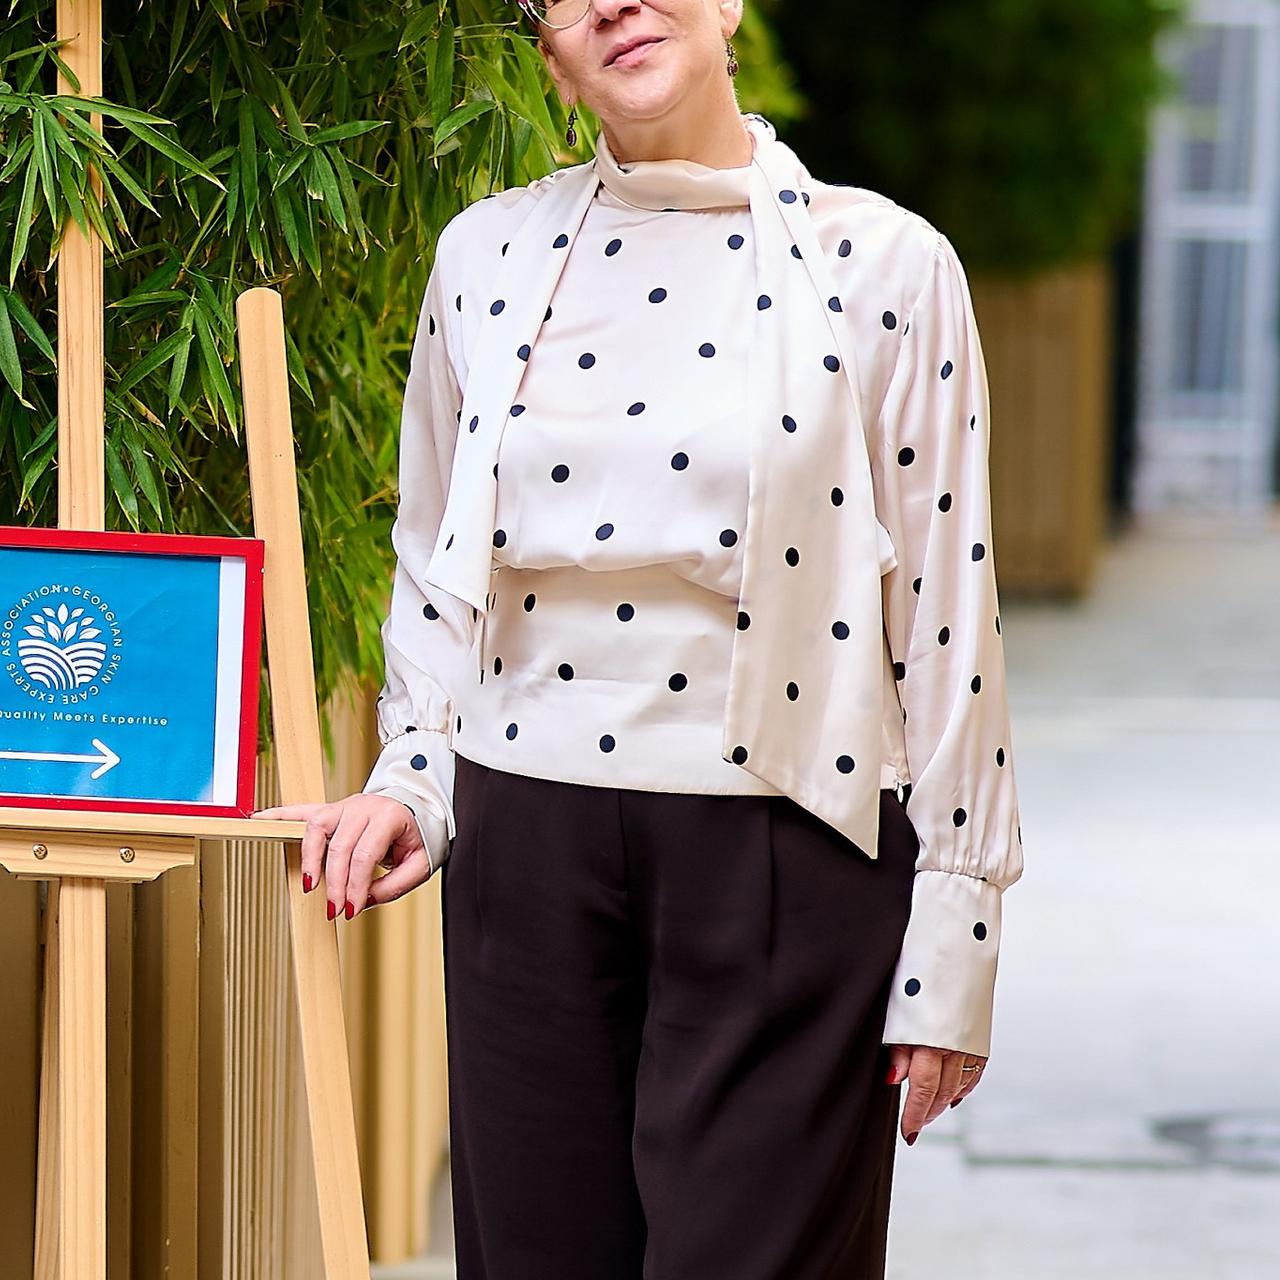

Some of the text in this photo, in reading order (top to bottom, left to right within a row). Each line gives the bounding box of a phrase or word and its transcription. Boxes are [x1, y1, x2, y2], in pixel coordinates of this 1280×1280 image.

[1, 584, 122, 705] GEORGIAN SKIN CARE EXPERTS ASSOCIATION
[53, 711, 96, 723] Meets
[102, 714, 168, 727] Expertise
